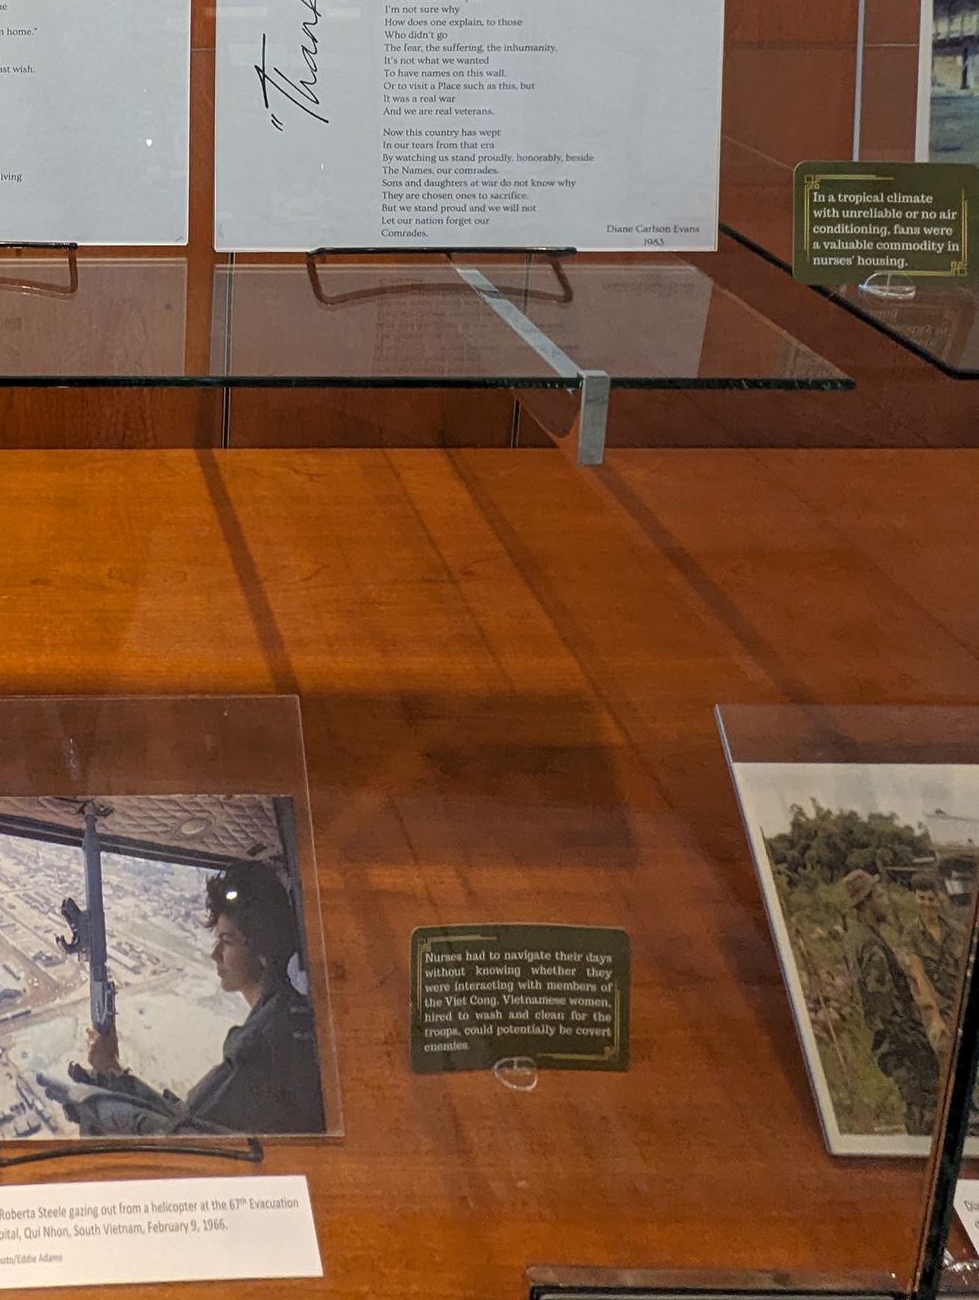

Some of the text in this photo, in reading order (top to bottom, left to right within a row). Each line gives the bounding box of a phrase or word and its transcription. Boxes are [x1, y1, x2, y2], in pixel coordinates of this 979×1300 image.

[383, 106, 402, 116] And
[403, 108, 417, 116] we
[418, 108, 433, 116] are
[435, 107, 452, 116] real
[812, 191, 934, 205] In a tropical climate
[813, 208, 958, 220] with unreliable or no air
[606, 224, 700, 234] Diane Carlson Evans
[893, 223, 921, 235] fans
[922, 226, 953, 236] were
[812, 239, 960, 254] a valuable commodity in
[813, 255, 909, 269] nurses' housing.
[424, 950, 612, 965] Nurses had to navigate their days
[424, 964, 613, 980] without knowing whether they
[37, 1205, 67, 1219] Steele
[68, 1204, 99, 1220] gazing
[100, 1204, 117, 1216] out
[118, 1202, 142, 1215] from
[143, 1204, 149, 1214] a
[150, 1201, 198, 1215] helicopter
[200, 1200, 210, 1212] at
[211, 1199, 227, 1211] the
[248, 1197, 299, 1210] Evacuation
[23, 1226, 41, 1240] Qui
[73, 1223, 101, 1237] South
[147, 1220, 189, 1234] February
[37, 1252, 63, 1263] Adams
